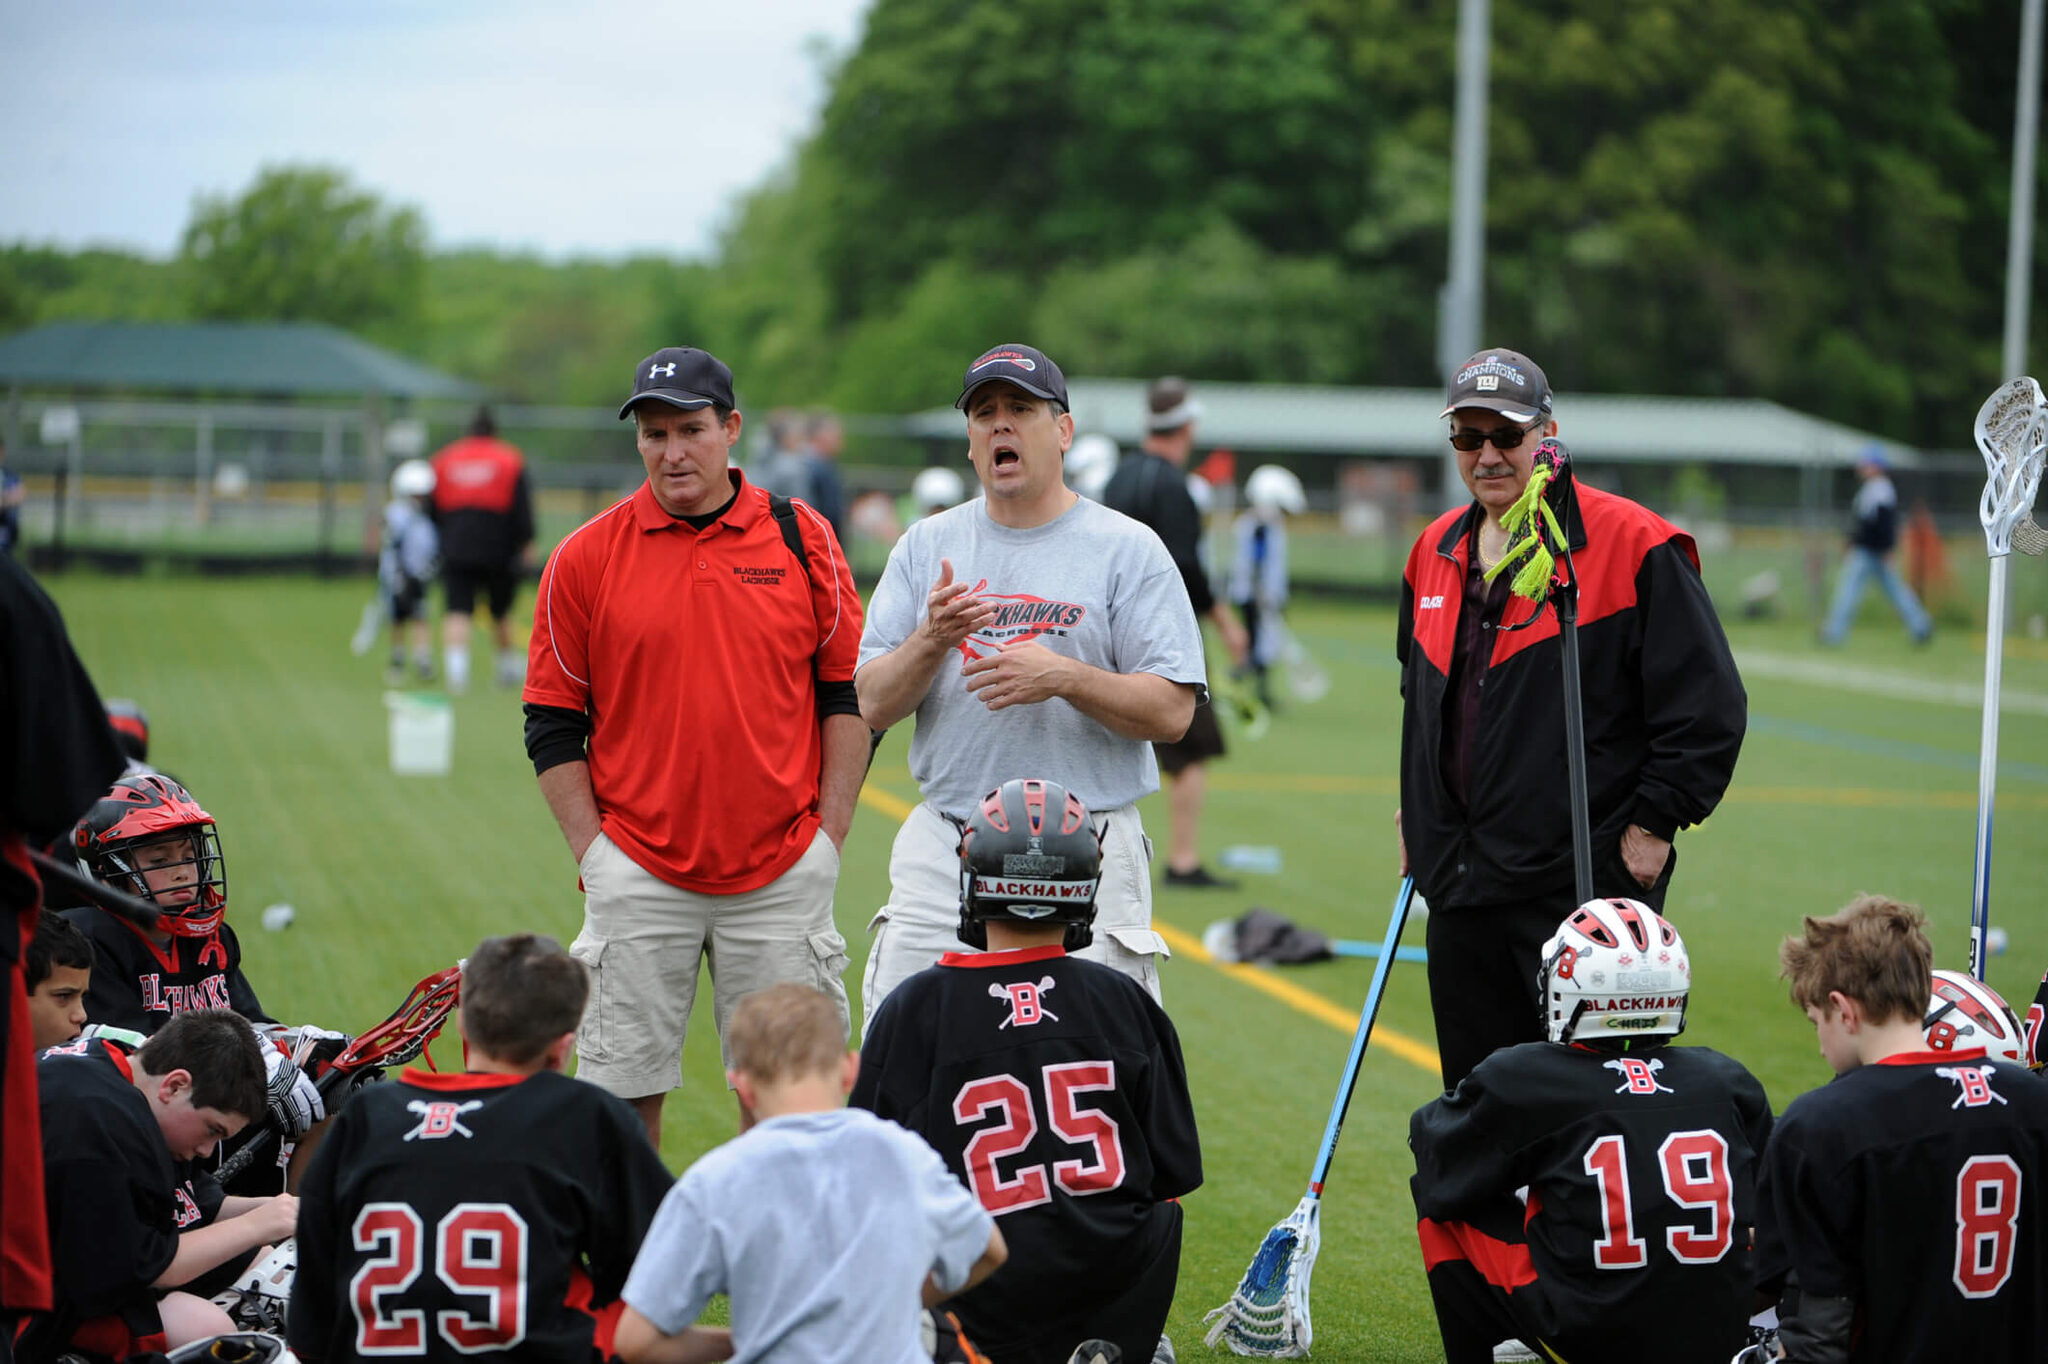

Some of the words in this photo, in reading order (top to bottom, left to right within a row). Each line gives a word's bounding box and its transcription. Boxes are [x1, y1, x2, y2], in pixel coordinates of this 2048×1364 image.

[1457, 364, 1526, 386] CHAMPIONS
[733, 567, 786, 577] BLACKHAWKS
[741, 575, 780, 585] LACROSSE
[993, 602, 1083, 626] KHAWKS
[974, 628, 1068, 638] ACROSSE
[975, 880, 1092, 897] BLACKHAWKS
[952, 1060, 1126, 1216] 25
[1583, 1129, 1735, 1270] 19
[1953, 1154, 2022, 1299] 8
[350, 1202, 528, 1356] 29
